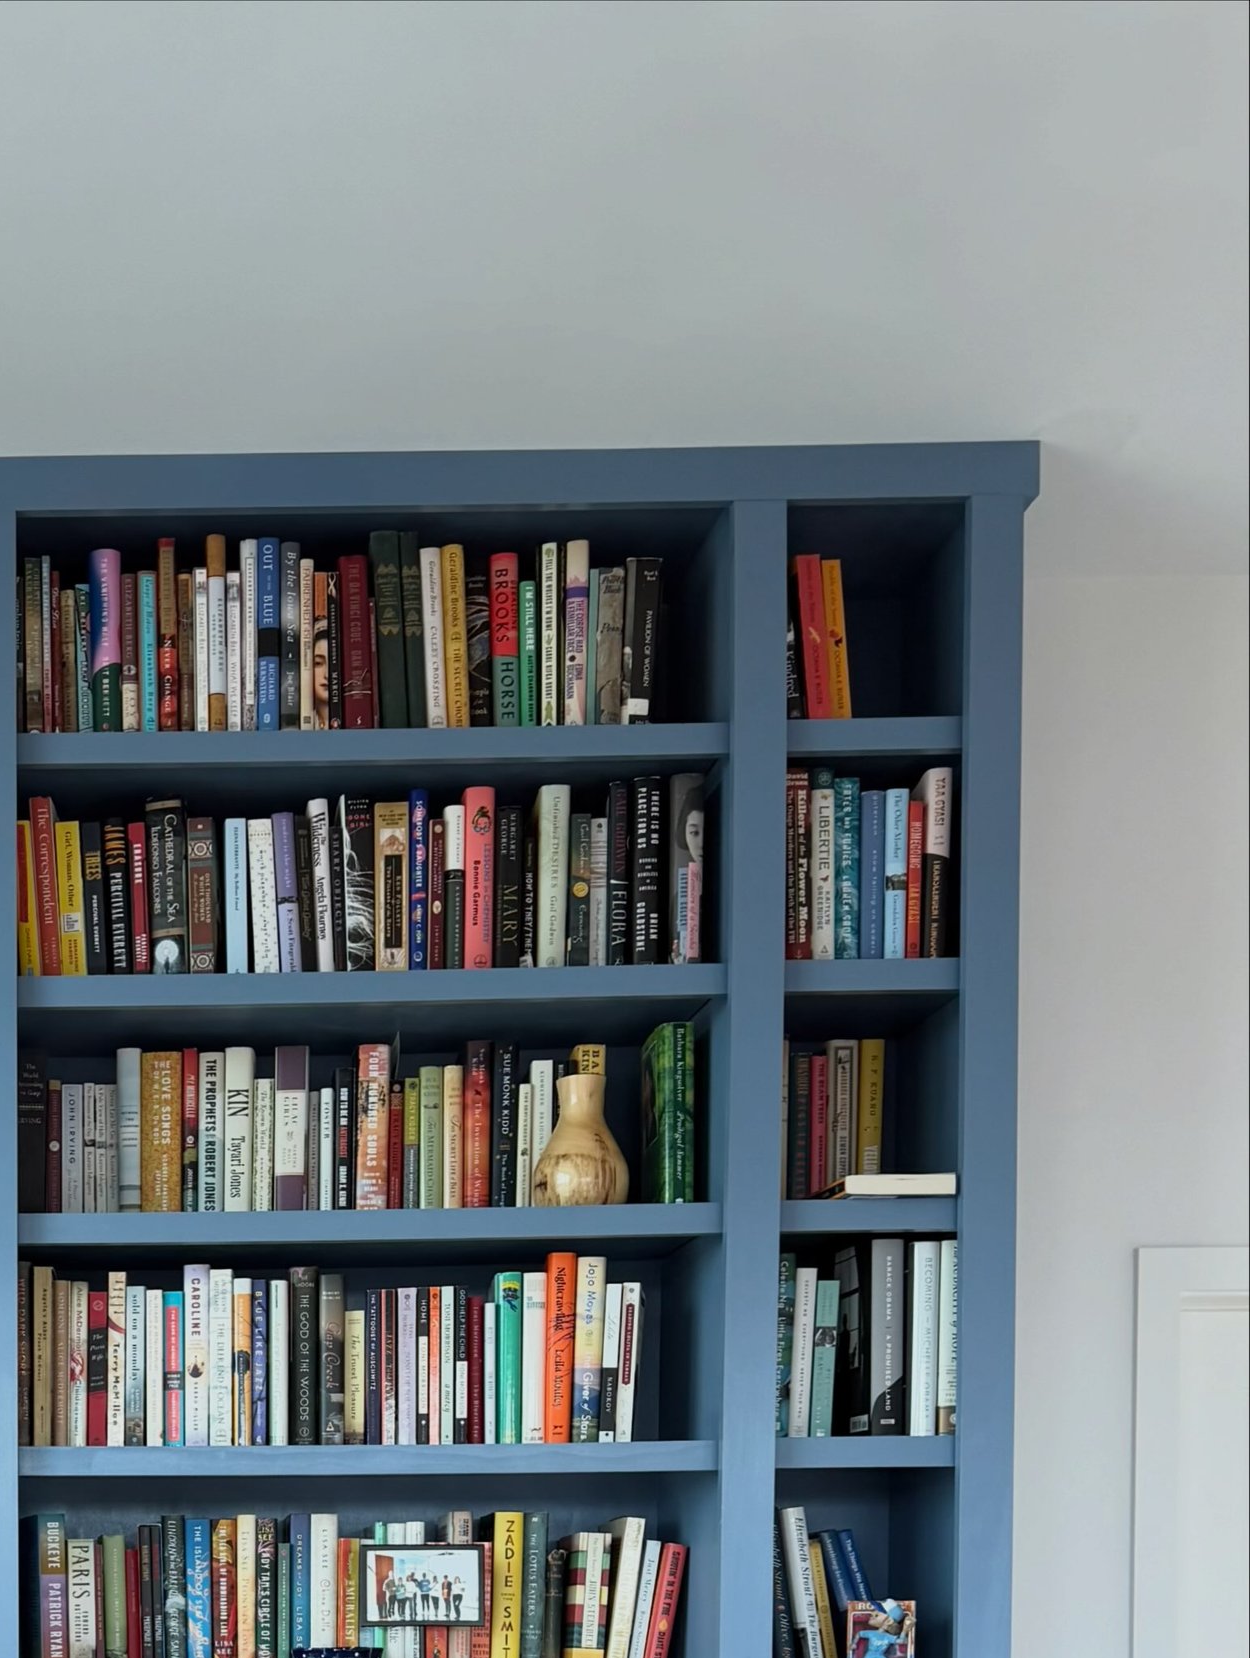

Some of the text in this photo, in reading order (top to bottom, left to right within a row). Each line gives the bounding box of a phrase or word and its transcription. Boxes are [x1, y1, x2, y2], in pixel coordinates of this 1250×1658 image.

[263, 545, 273, 571] OUT
[263, 595, 273, 625] BLUE
[494, 568, 509, 643] BROOKS
[526, 602, 534, 625] STILL
[526, 628, 534, 651] HERE
[501, 662, 514, 720] HORSE
[37, 807, 54, 925] The Correspondent
[85, 851, 101, 881] TREES
[104, 825, 126, 866] JAMES
[164, 814, 180, 923] CATHEDRAL SEA
[798, 790, 808, 944] Killers Flower Moon
[819, 806, 830, 871] LIBERTIE
[910, 821, 920, 870] HOMEGOING
[109, 872, 126, 968] PERCIVAL EVERETT
[503, 884, 518, 946] MARY
[611, 890, 627, 946] FLORA
[161, 1070, 171, 1145] LOVE SONGS
[205, 1060, 217, 1132] THE PROPHETS
[227, 1089, 249, 1117] KIN
[501, 1052, 511, 1135] SUE MONK KIDD
[205, 1141, 216, 1212] ROBERT JONES
[227, 1136, 245, 1198] Tayari Jones
[191, 1277, 201, 1337] CAROLINE
[554, 1266, 565, 1332] Nightcrawling
[300, 1295, 310, 1421] THE GOD OF THE WOODS
[580, 1372, 593, 1440] Giver Stars
[605, 1376, 613, 1413] NABOKOV
[47, 1521, 61, 1569] BUCKEYE
[505, 1520, 515, 1588] ZADIE
[794, 1516, 813, 1597] Elizabeth Strout
[345, 1586, 355, 1641] MURALIST
[528, 1549, 539, 1618] LOTUS EATERS
[49, 1582, 63, 1658] PATRICK RYAN
